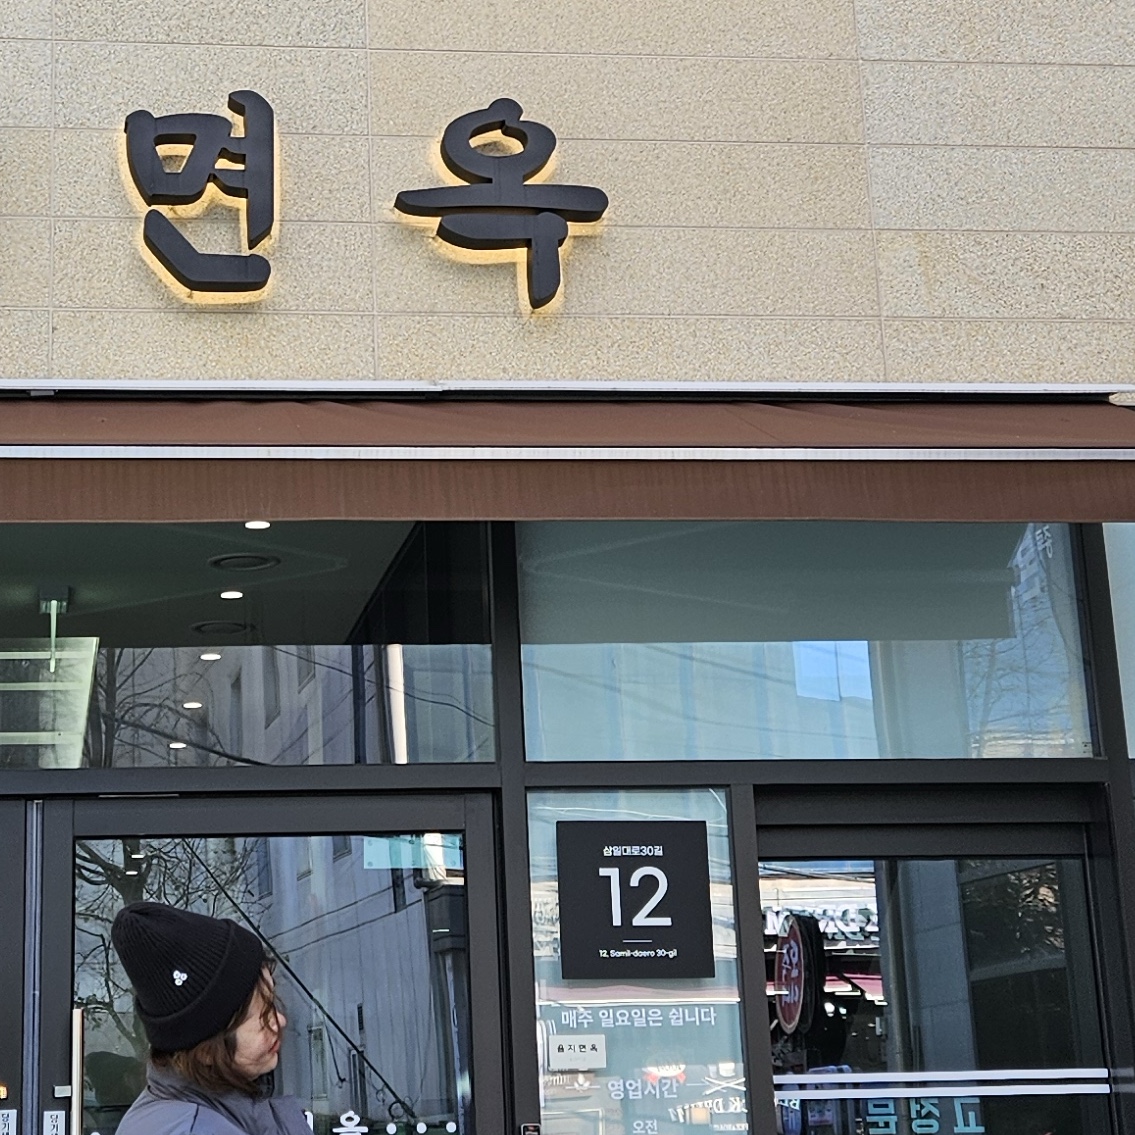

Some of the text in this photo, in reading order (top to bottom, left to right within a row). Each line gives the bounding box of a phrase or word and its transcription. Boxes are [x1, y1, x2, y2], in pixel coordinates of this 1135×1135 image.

[603, 846, 664, 856] 삼일대로30길
[599, 866, 672, 926] 12
[610, 949, 655, 957] Samil-daero
[656, 949, 677, 958] 30-gil
[561, 1006, 716, 1029] 매주 일요일은 쉽니다
[607, 1078, 679, 1100] 영업시간
[632, 1120, 658, 1134] 오전
